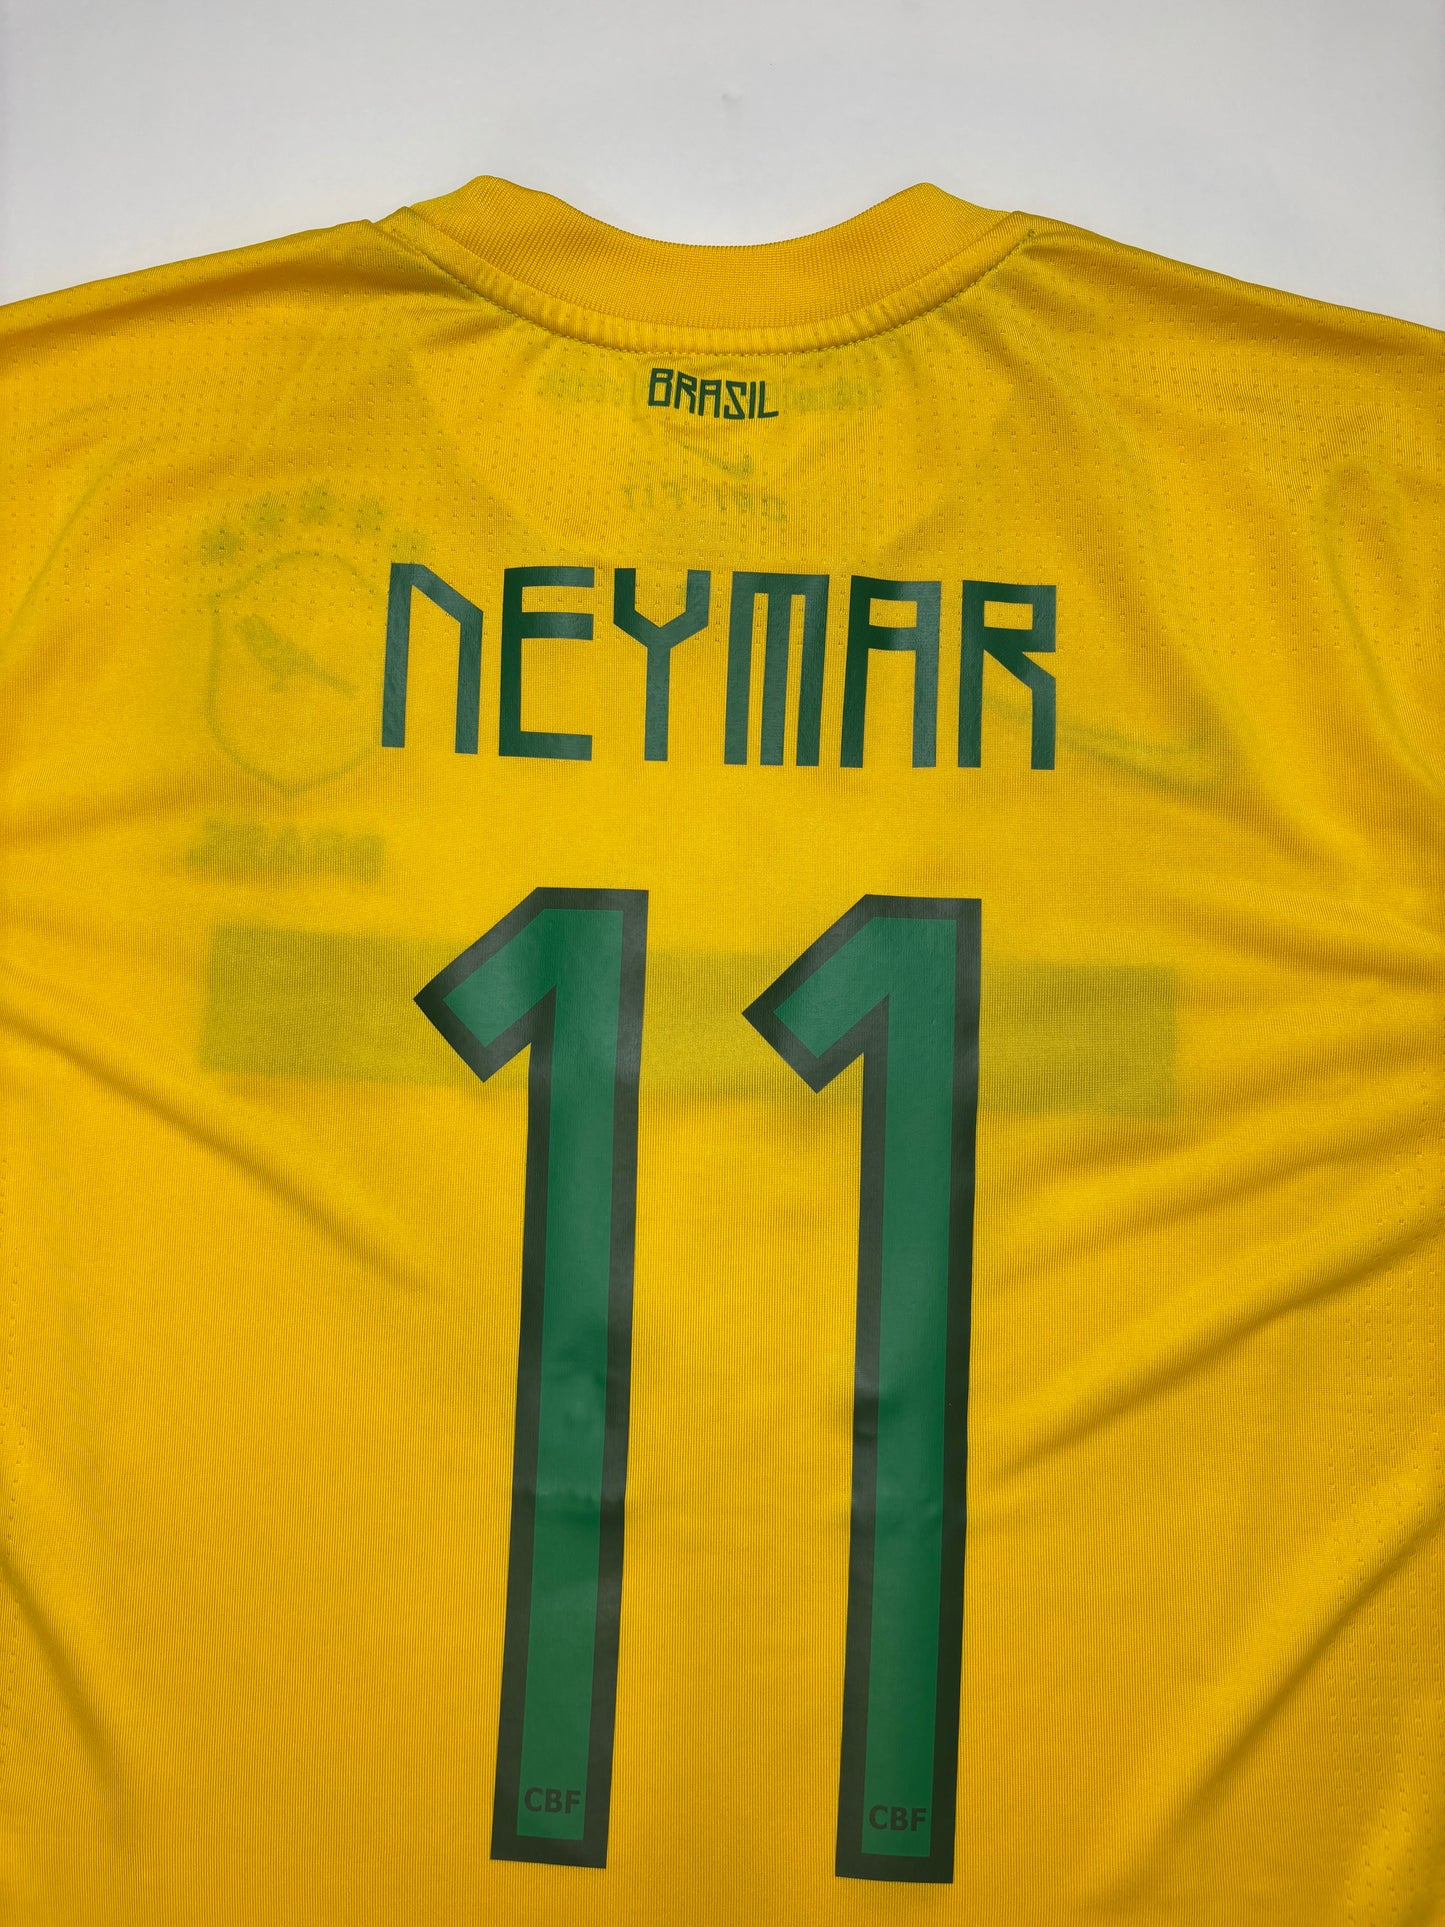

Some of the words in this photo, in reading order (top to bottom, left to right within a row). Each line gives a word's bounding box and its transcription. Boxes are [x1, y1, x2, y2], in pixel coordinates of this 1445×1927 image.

[647, 367, 779, 421] BRASIL
[381, 562, 1057, 771] NEYMAR
[414, 886, 981, 1883] 11
[524, 1786, 581, 1814] CBF
[869, 1804, 927, 1832] CBF
